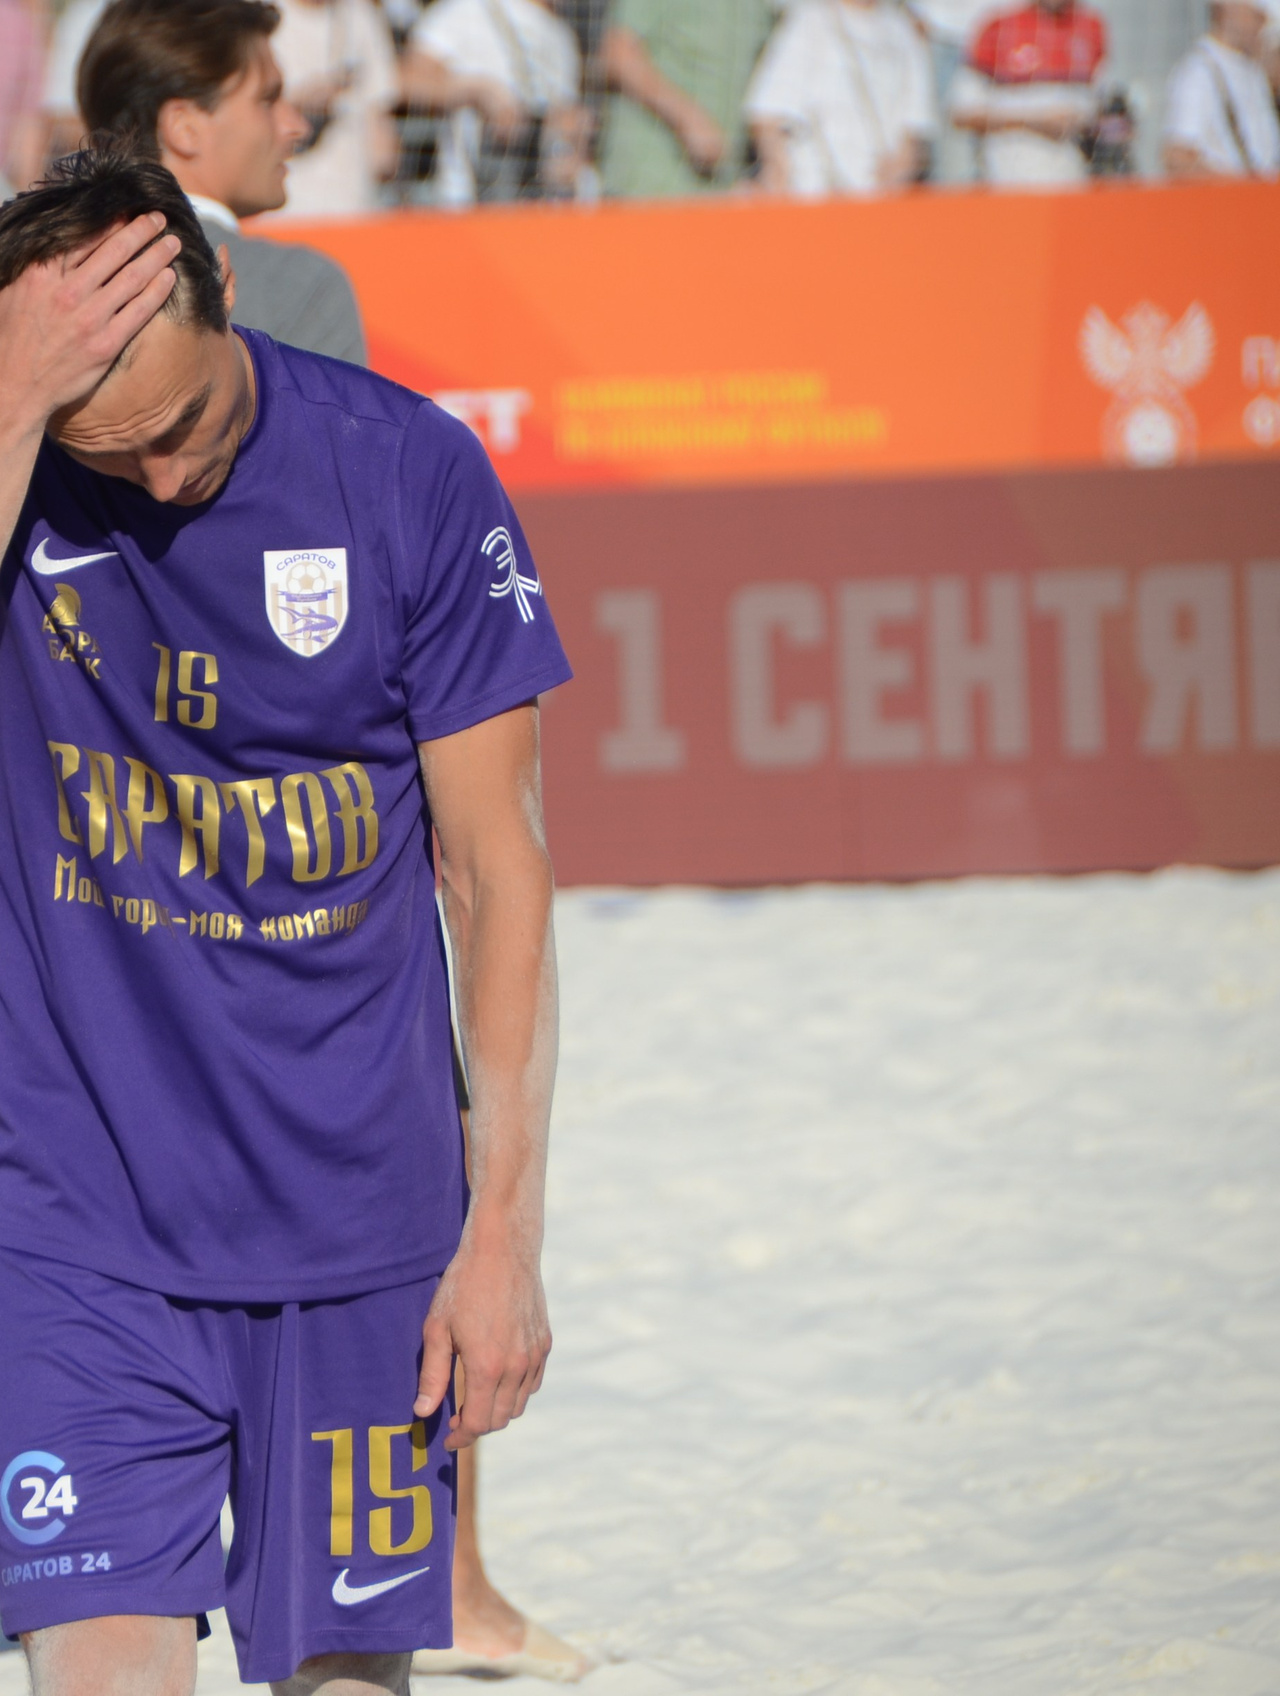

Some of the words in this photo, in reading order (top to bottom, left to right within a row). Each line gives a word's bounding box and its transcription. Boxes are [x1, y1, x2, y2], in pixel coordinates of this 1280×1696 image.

[276, 552, 337, 571] САРАТОВ
[151, 641, 219, 730] 15
[596, 588, 687, 774] 1
[47, 739, 379, 888] САРАТОВ
[311, 1421, 433, 1556] 15
[1, 1555, 73, 1587] САРАТОВ
[81, 1551, 112, 1574] 24
